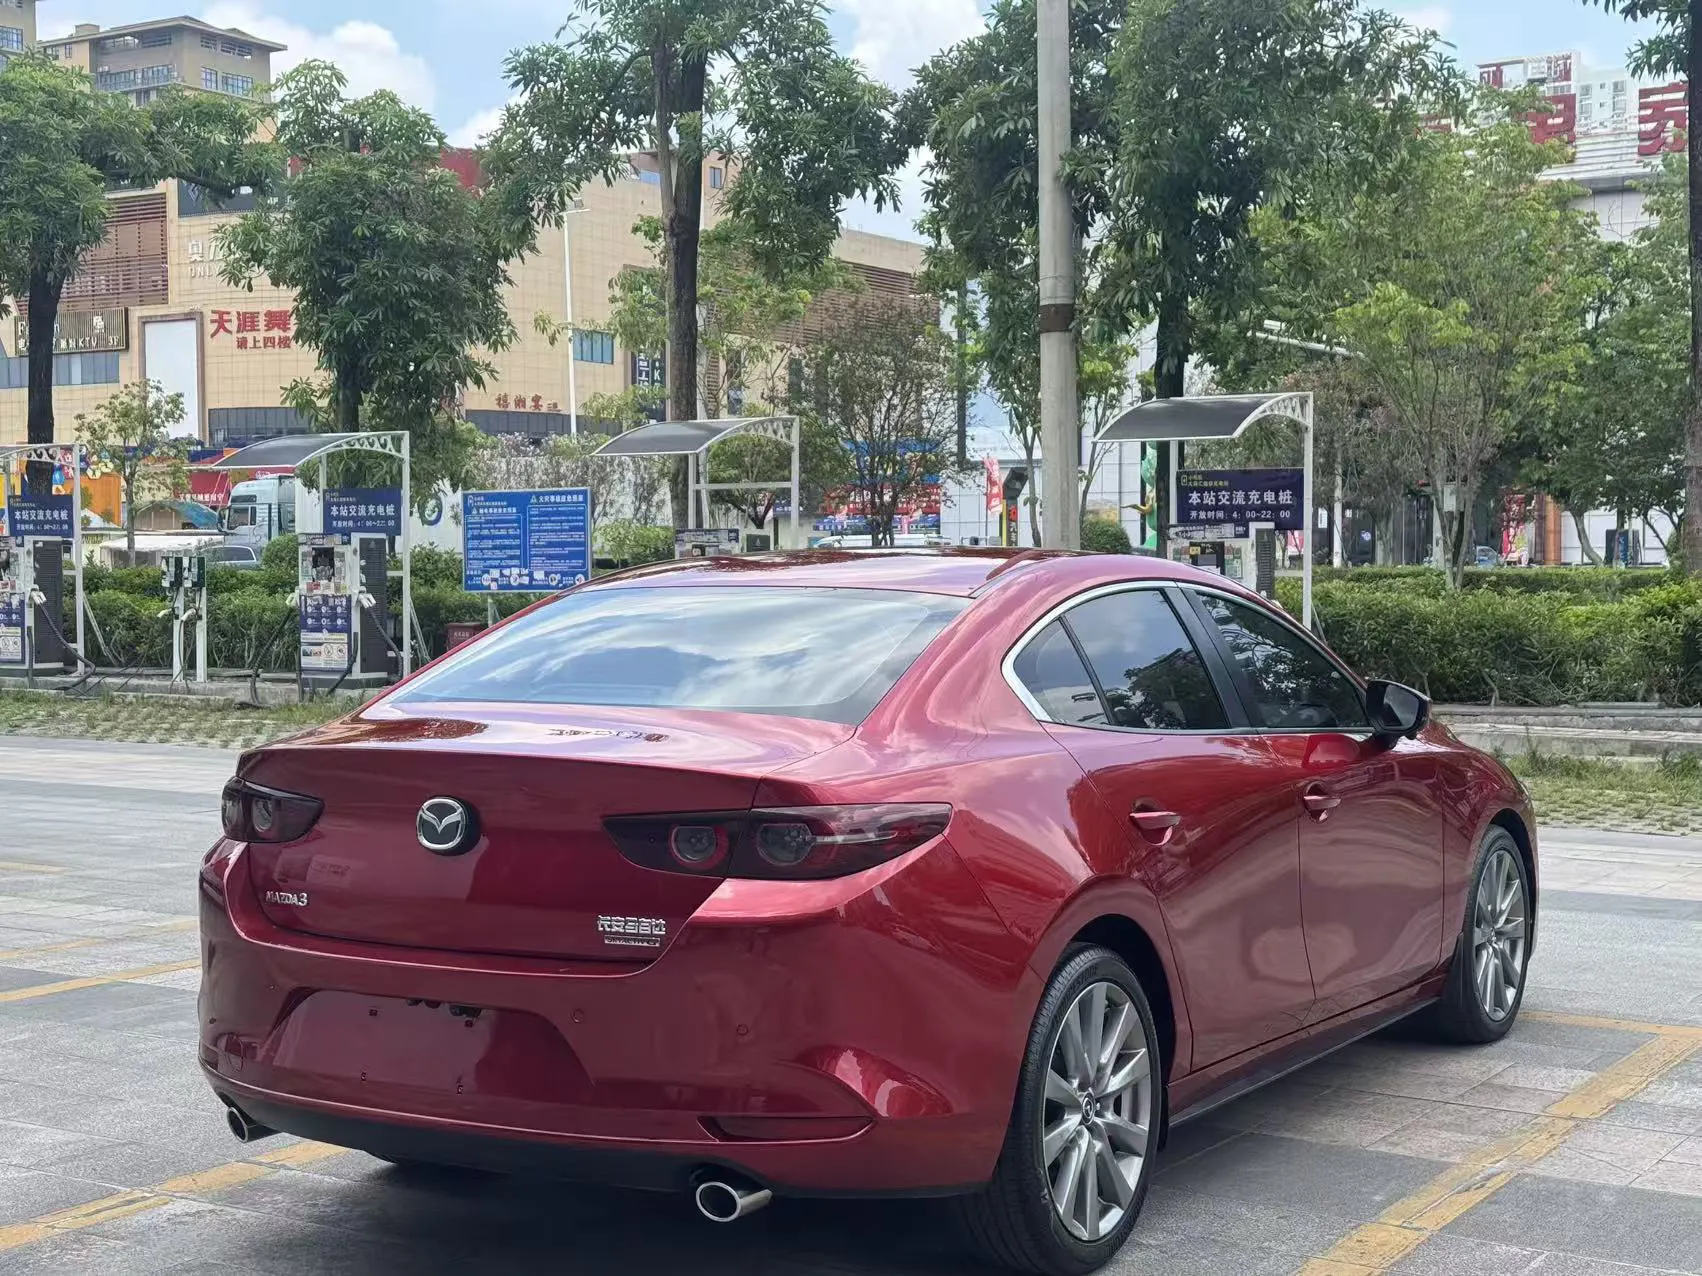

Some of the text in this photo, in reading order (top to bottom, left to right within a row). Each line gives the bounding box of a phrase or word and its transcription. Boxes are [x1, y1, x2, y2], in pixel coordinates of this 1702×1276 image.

[210, 309, 291, 338] 天涯舞
[236, 336, 291, 350] 请上四楼
[1188, 490, 1293, 506] 本站交流充电桩
[14, 509, 69, 521] 本站交流充电桩
[330, 504, 395, 517] 本站交流充电桩
[597, 914, 666, 935] 长安马自达
